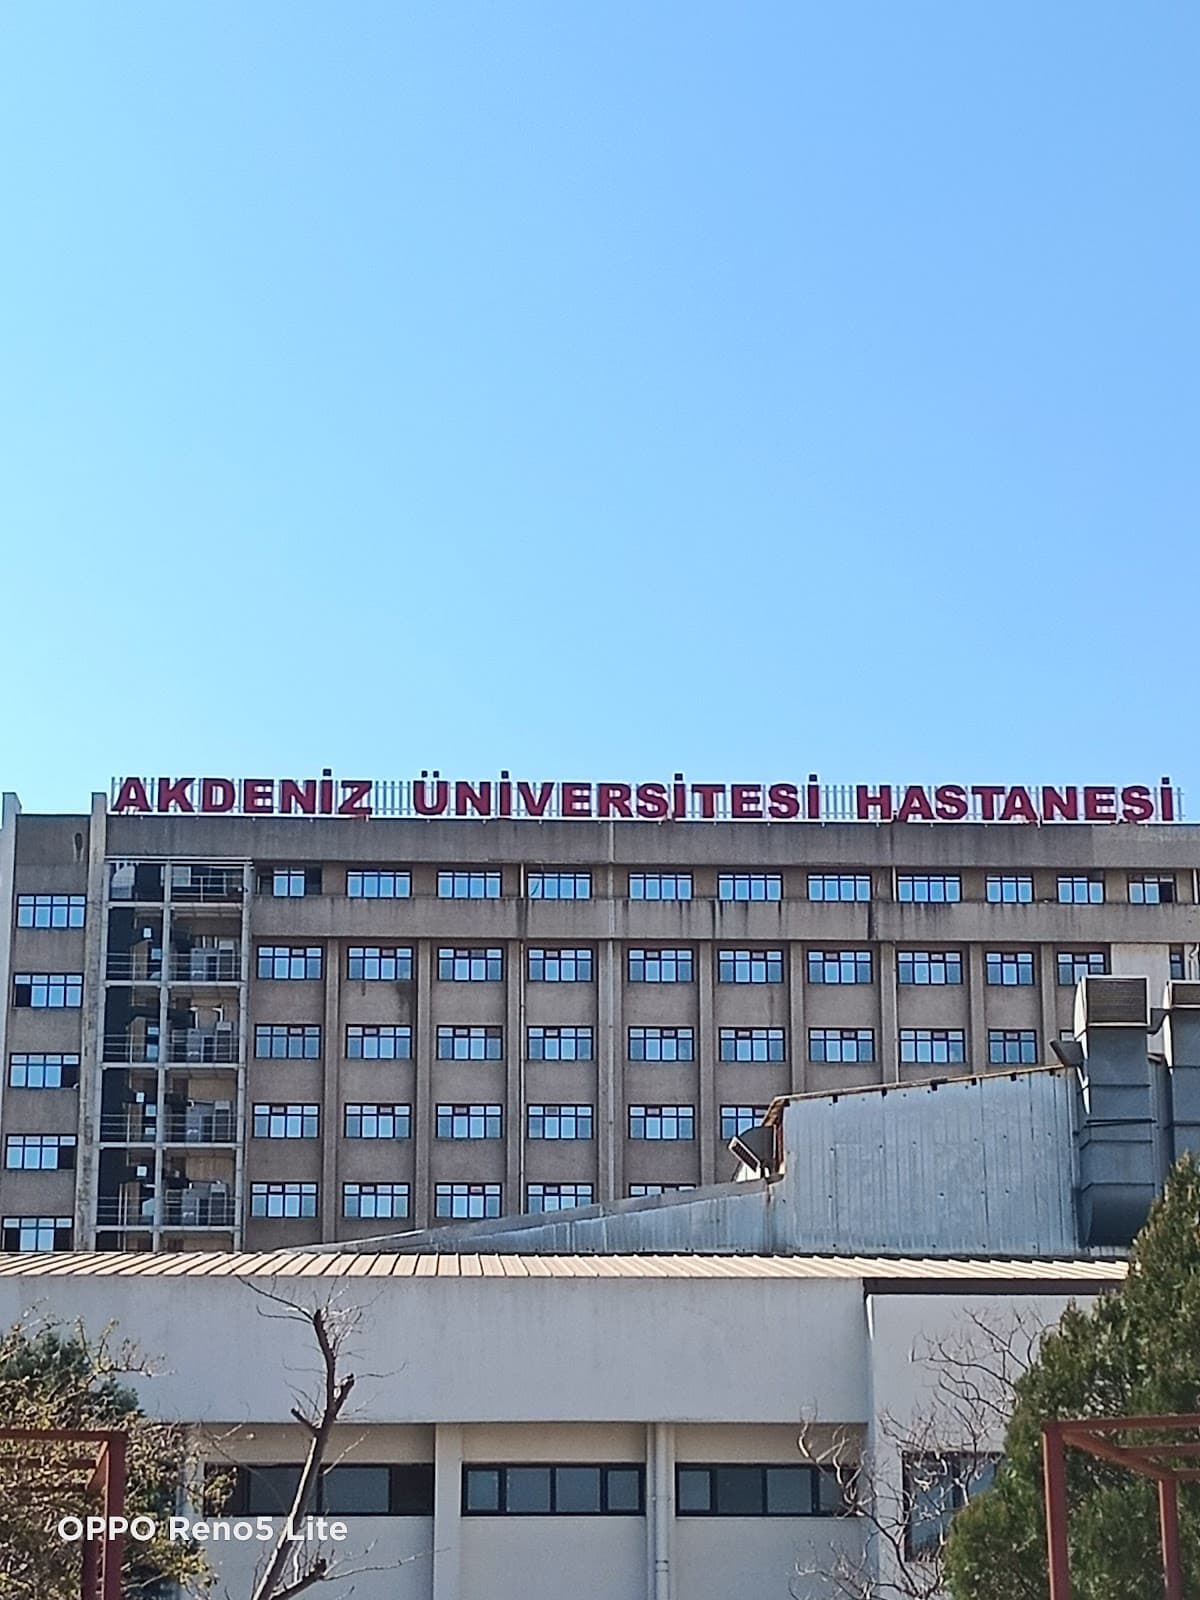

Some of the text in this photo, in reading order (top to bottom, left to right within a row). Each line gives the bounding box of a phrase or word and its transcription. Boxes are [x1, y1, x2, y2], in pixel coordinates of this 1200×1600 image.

[113, 769, 1174, 822] AKDENİZ ÜNİVERSİTESİ HASTANESİ
